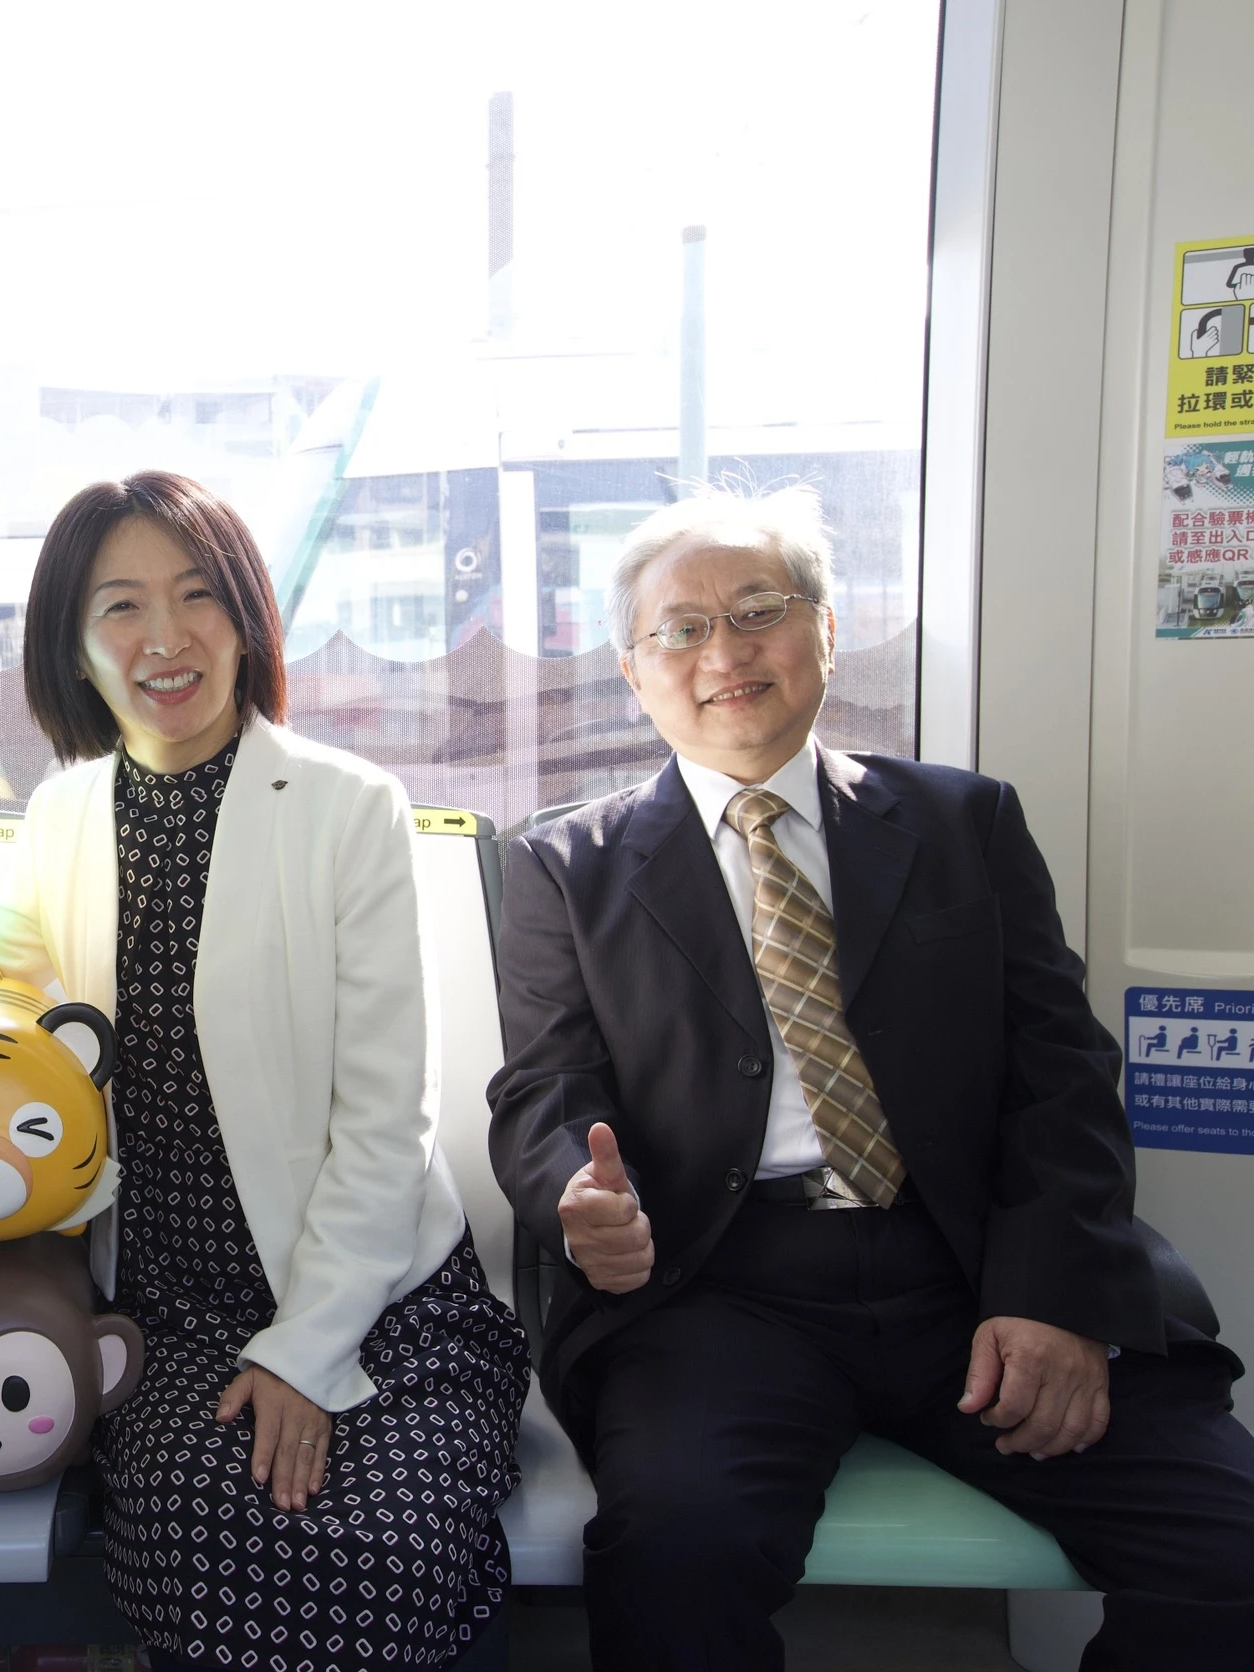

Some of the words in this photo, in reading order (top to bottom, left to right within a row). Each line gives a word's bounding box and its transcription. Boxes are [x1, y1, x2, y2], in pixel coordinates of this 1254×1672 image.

[1205, 364, 1254, 386] 請緊
[1177, 389, 1254, 414] 拉環或
[1203, 420, 1222, 428] hold
[1168, 548, 1249, 564] 或感應QR
[413, 818, 431, 831] ap
[1139, 994, 1205, 1013] 優先席
[1133, 1120, 1168, 1132] Please
[1171, 1124, 1195, 1134] offer
[1197, 1127, 1226, 1136] seats
[1229, 1128, 1239, 1136] to
